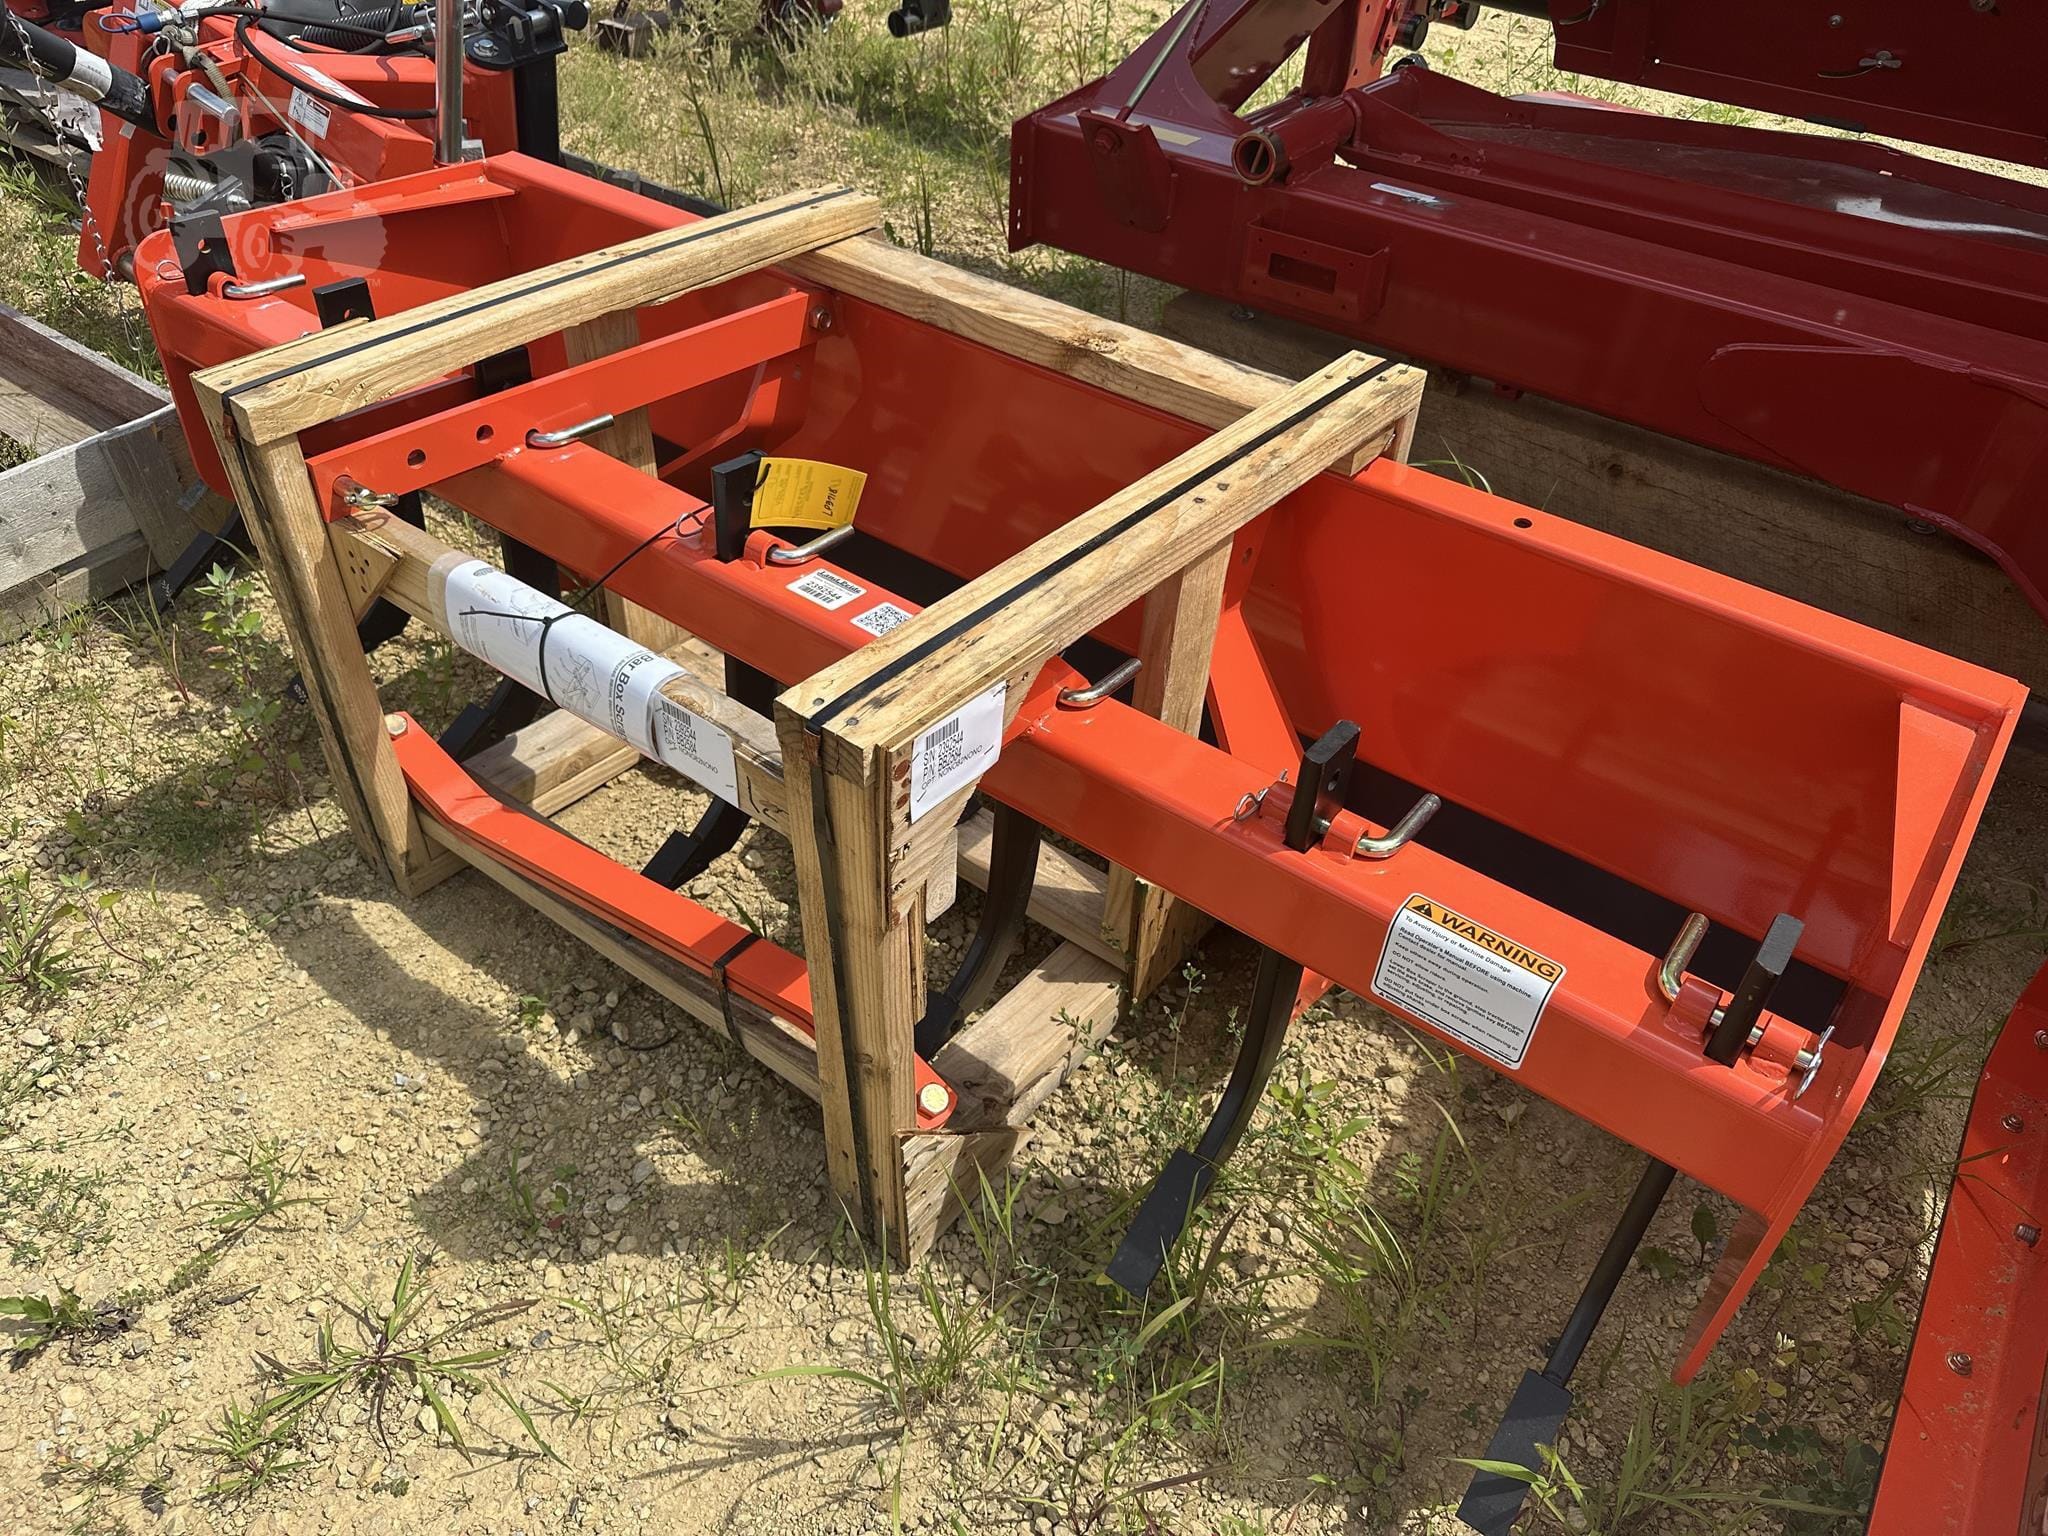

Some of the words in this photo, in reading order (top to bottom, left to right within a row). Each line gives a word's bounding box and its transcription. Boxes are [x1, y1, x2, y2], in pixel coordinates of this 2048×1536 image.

[628, 654, 654, 671] Bar
[616, 672, 630, 702] Box
[1398, 932, 1419, 946] Contact
[1420, 944, 1436, 955] dealer
[1437, 952, 1446, 960] for
[1413, 920, 1432, 932] Avoid
[1432, 929, 1450, 942] Injury
[1458, 943, 1484, 959] Machine
[1441, 913, 1556, 978] WARNING
[1400, 926, 1415, 937] Read
[1414, 934, 1444, 952] Operator's
[1444, 949, 1464, 964] Manual
[1464, 959, 1488, 977] BEFORE
[1490, 974, 1506, 986] using
[1402, 955, 1414, 964] NOT
[1496, 1022, 1520, 1036] BEFORE
